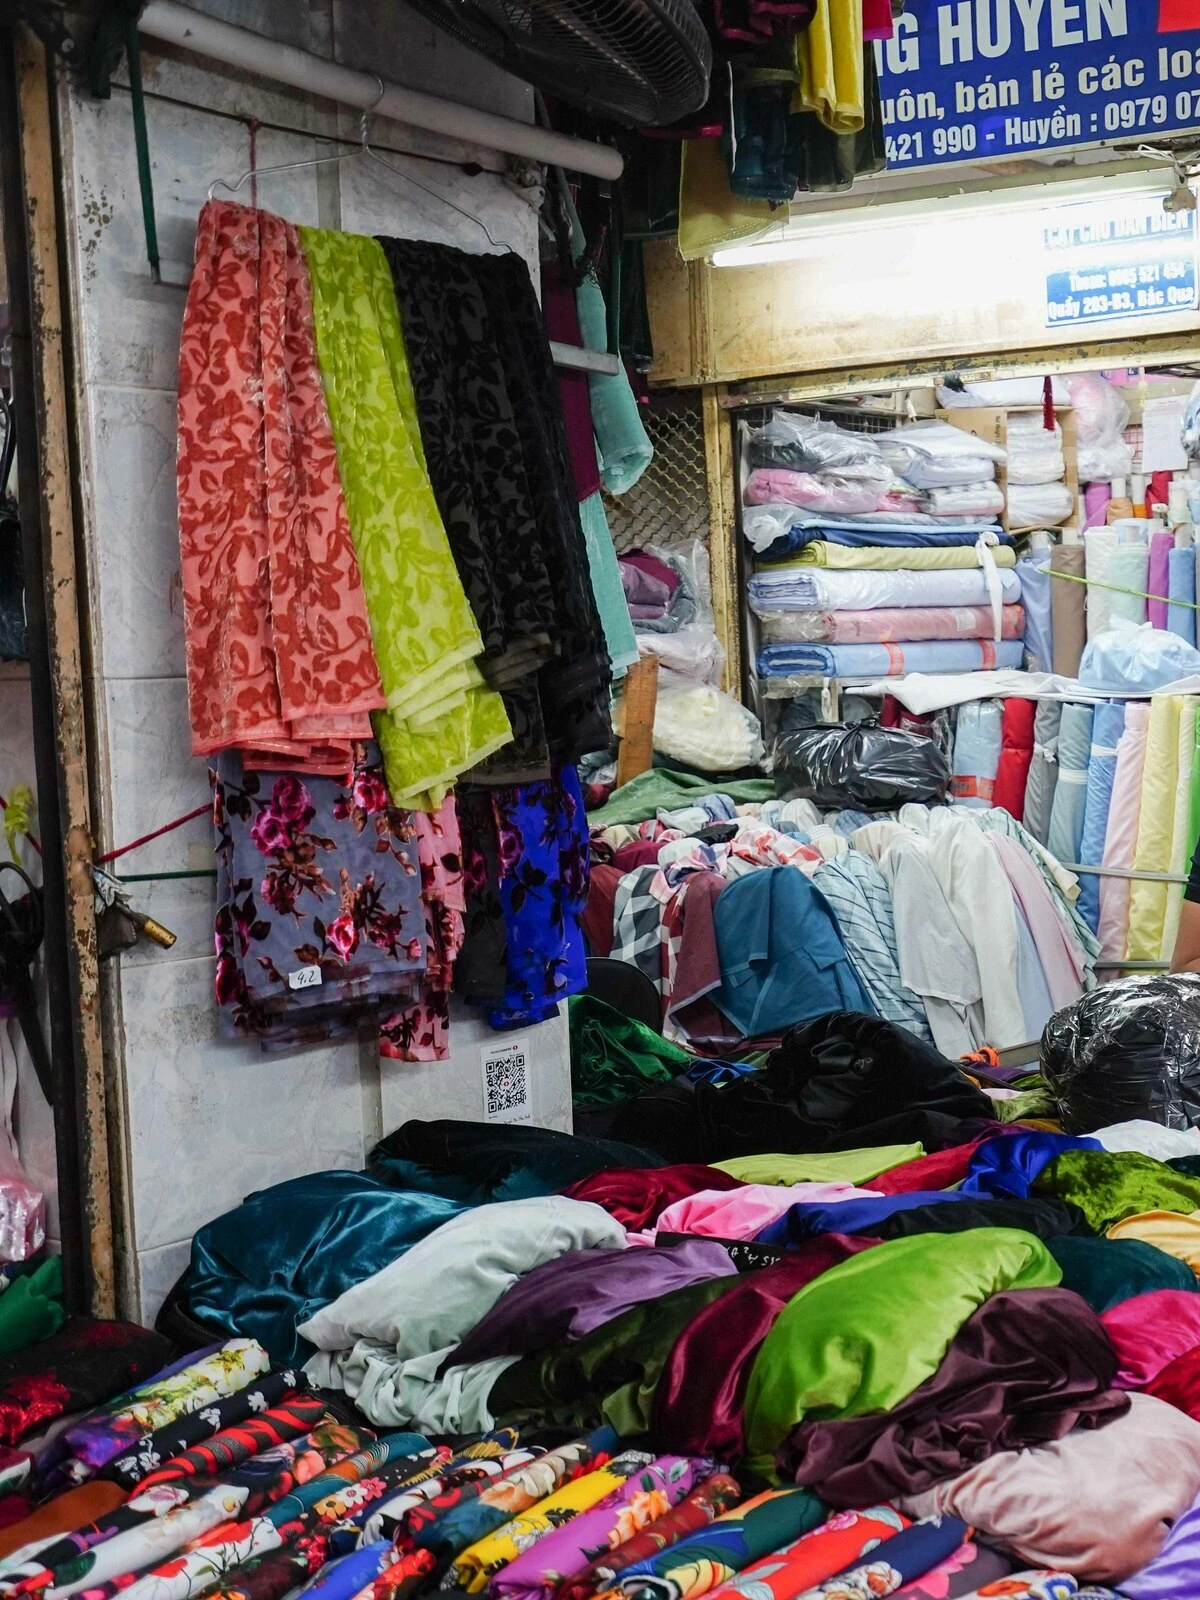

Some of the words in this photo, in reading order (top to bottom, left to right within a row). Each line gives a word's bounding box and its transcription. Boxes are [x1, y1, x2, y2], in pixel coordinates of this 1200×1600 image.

[873, 12, 920, 76] G
[881, 88, 945, 125] uôn,
[955, 75, 1019, 114] bán
[1032, 62, 1065, 103] lẻ
[1078, 55, 1145, 95] các
[932, 124, 976, 156] 990
[1104, 95, 1167, 131] 0979
